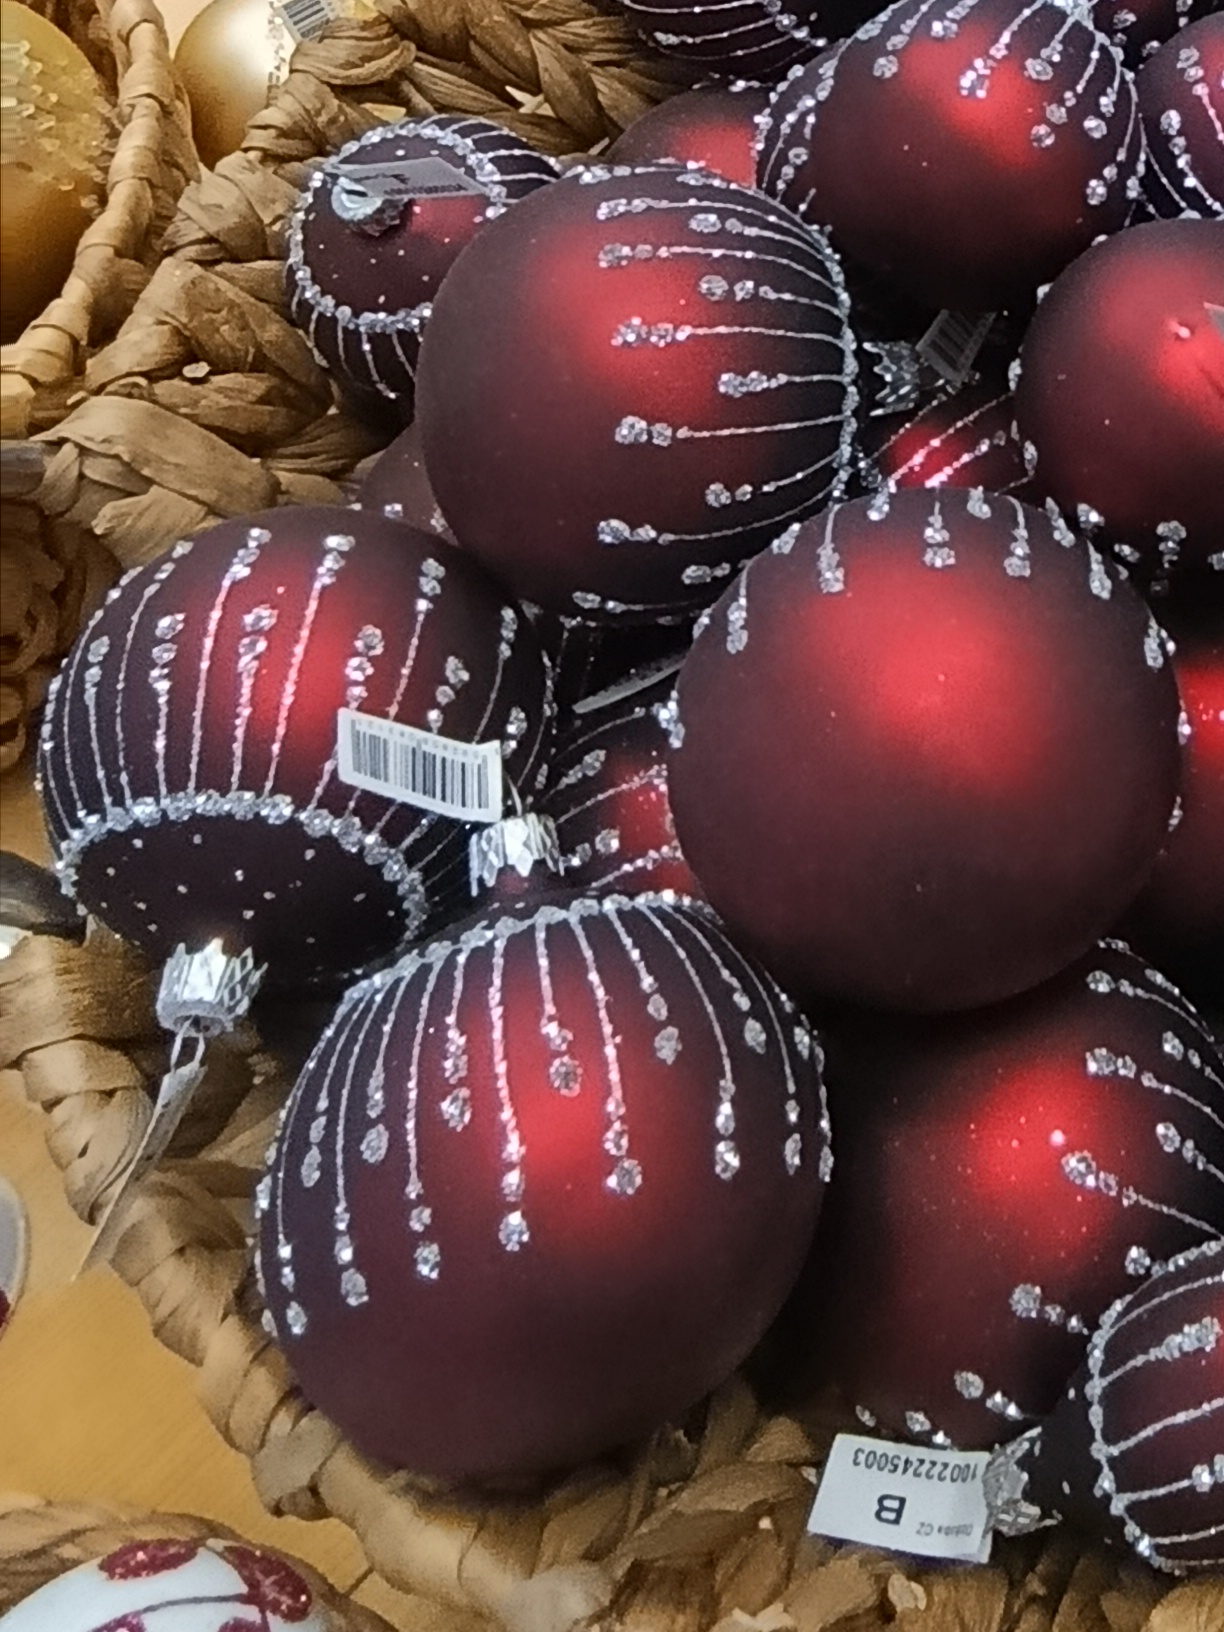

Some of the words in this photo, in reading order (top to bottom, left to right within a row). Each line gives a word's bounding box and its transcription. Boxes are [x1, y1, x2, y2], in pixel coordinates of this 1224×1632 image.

[852, 1447, 978, 1483] 10022245003
[874, 1493, 906, 1525] B
[915, 1522, 934, 1536] CZ
